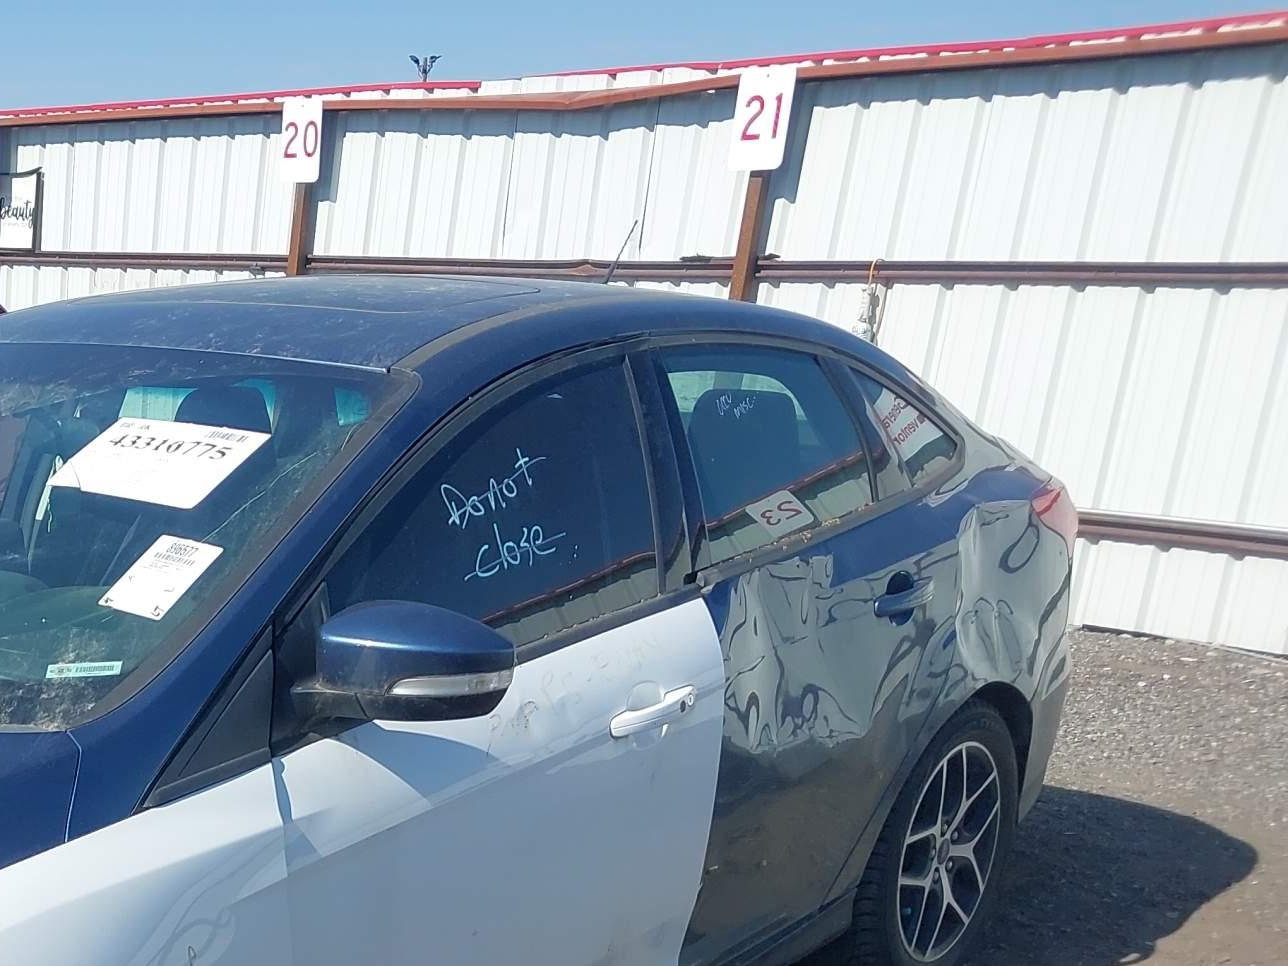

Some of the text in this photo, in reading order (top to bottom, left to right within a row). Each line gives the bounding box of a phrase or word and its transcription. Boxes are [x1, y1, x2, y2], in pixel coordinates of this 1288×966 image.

[740, 93, 784, 142] 21
[283, 120, 318, 159] 20
[0, 197, 34, 229] beauty
[109, 434, 232, 460] 43310775
